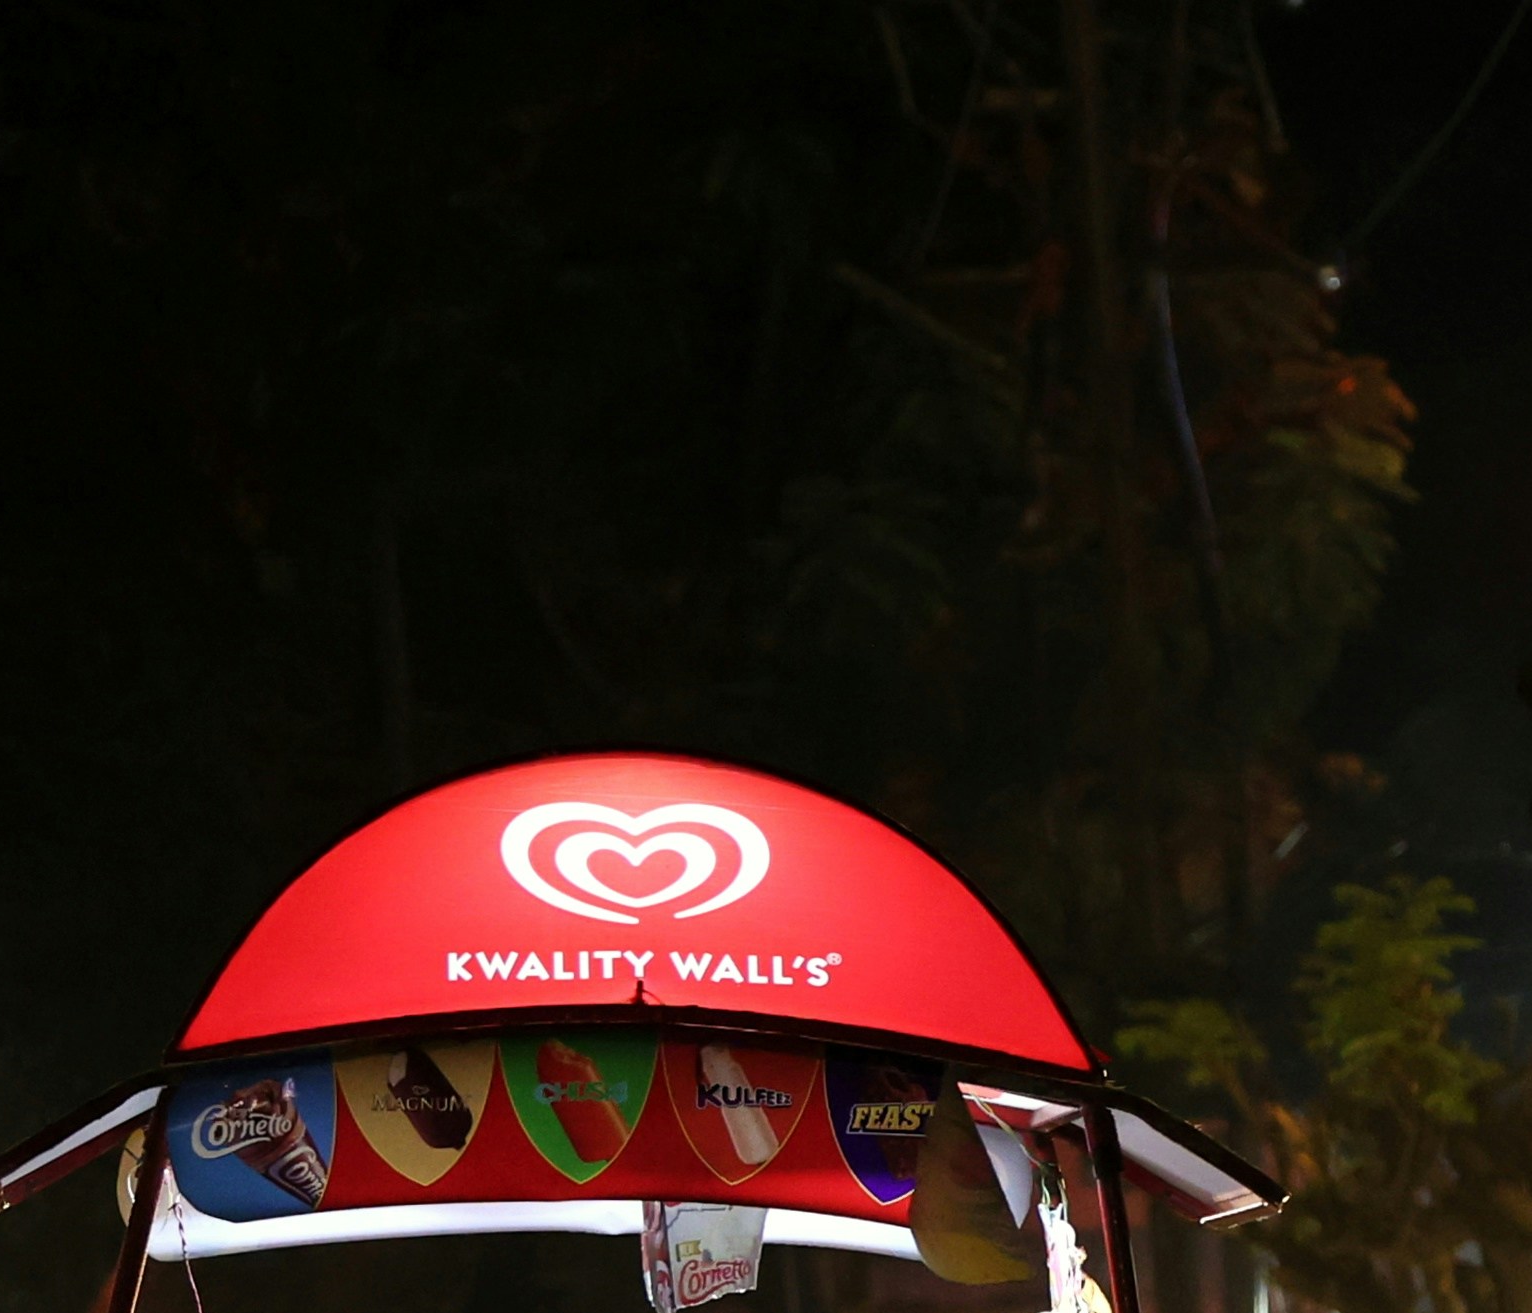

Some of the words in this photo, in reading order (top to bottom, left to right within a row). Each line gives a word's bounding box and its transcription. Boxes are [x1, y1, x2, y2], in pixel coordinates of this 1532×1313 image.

[447, 950, 655, 982] KWALITY
[371, 1095, 470, 1112] MAGNUM
[191, 1104, 293, 1159] Cornetto
[679, 1259, 752, 1305] Cornetto
